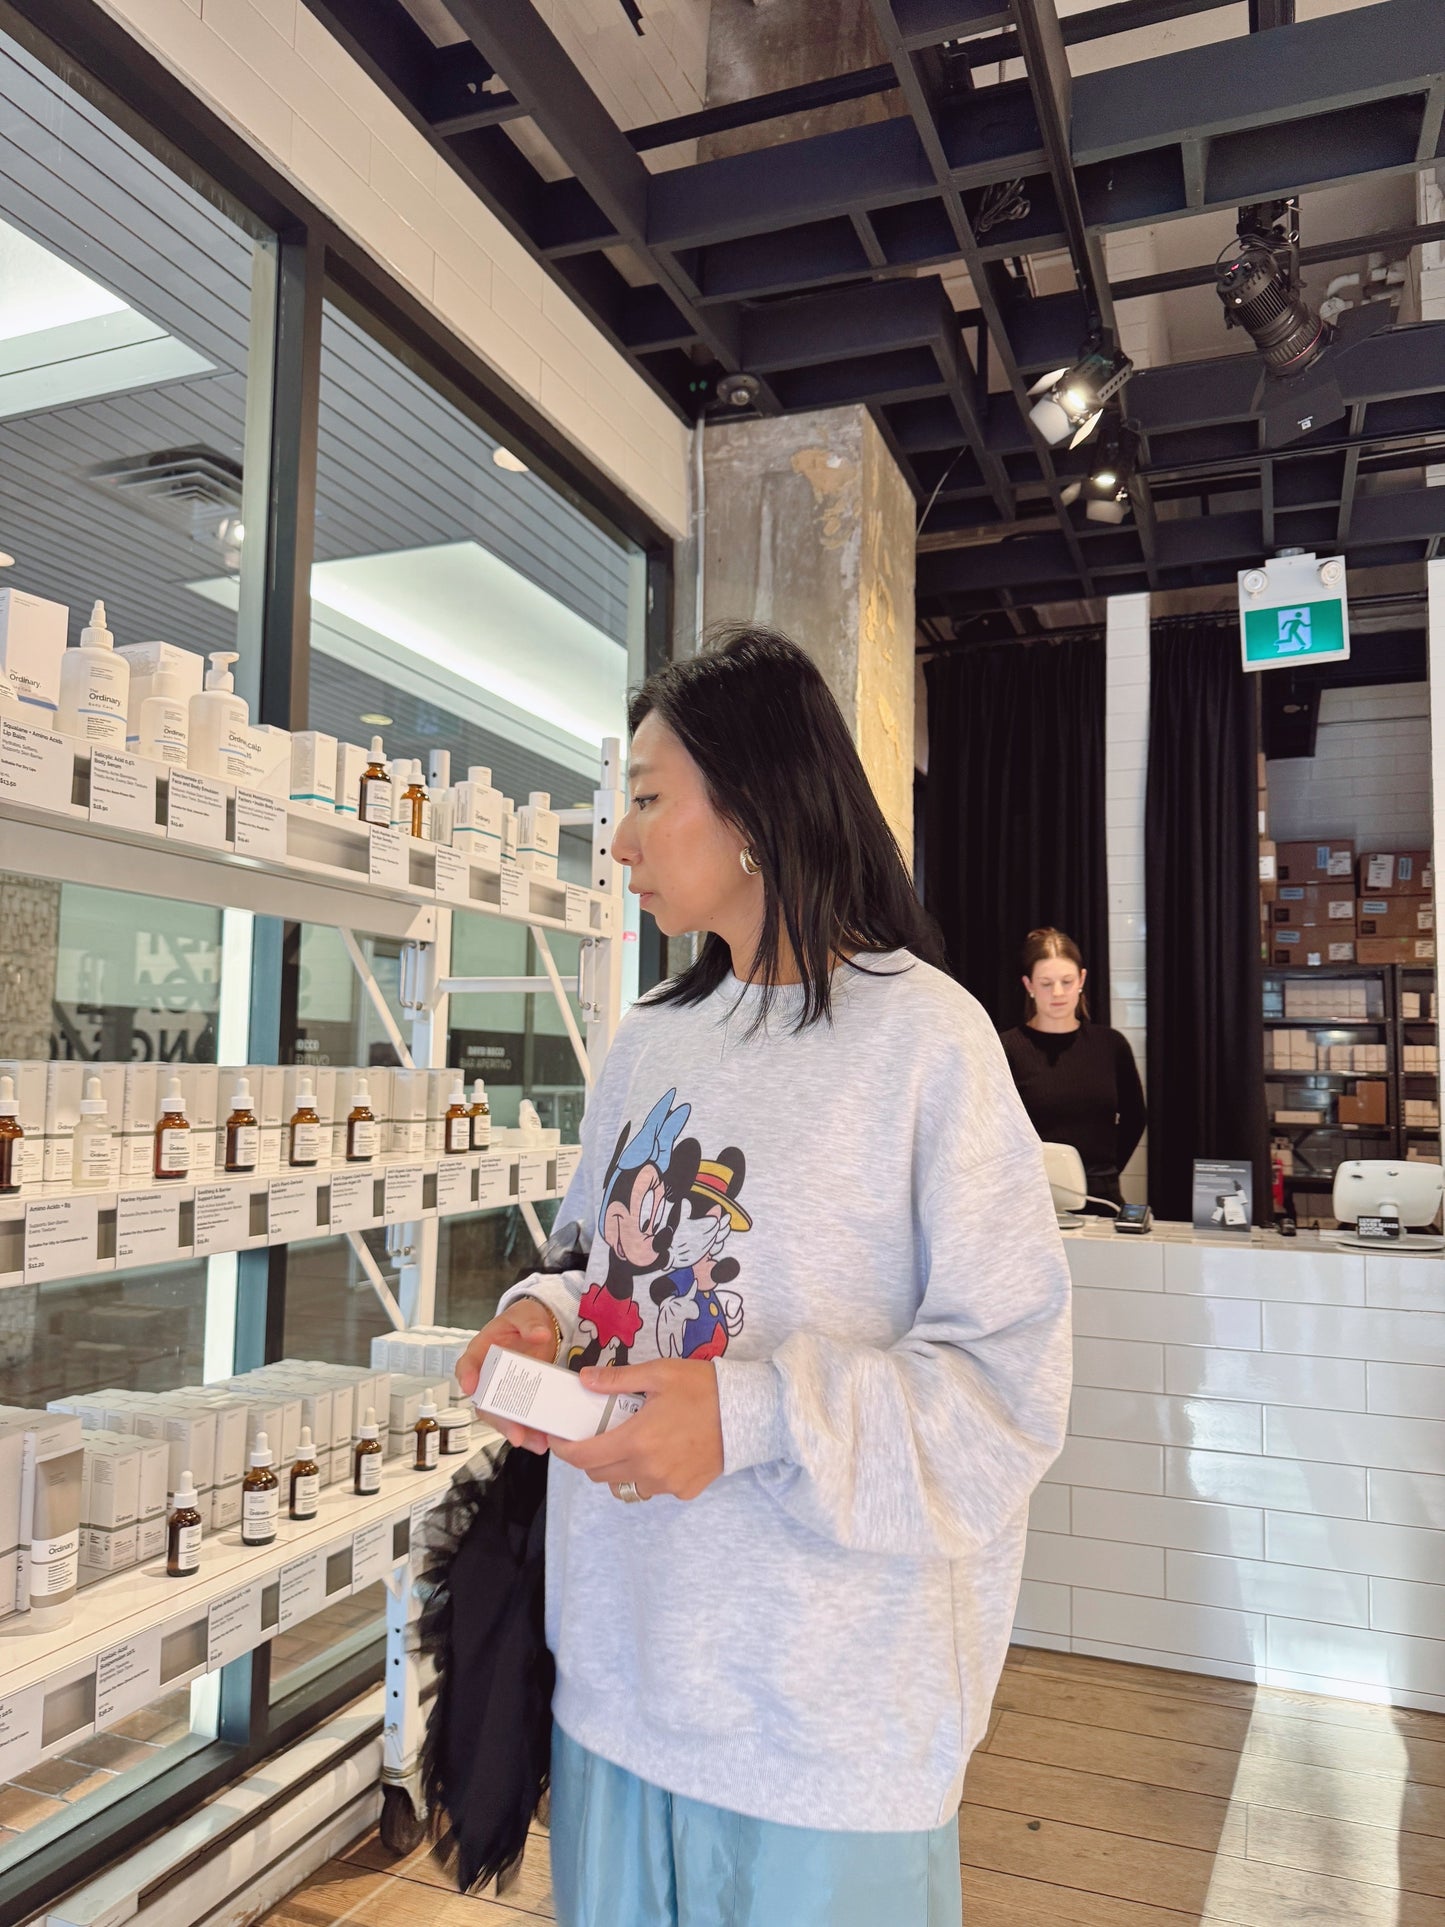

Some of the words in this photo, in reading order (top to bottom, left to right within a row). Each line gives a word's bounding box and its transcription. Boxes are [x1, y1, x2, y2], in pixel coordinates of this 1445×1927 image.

[3, 722, 28, 734] Squalane
[32, 731, 48, 741] Amino
[49, 736, 63, 745] Acids
[13, 733, 26, 741] Balm
